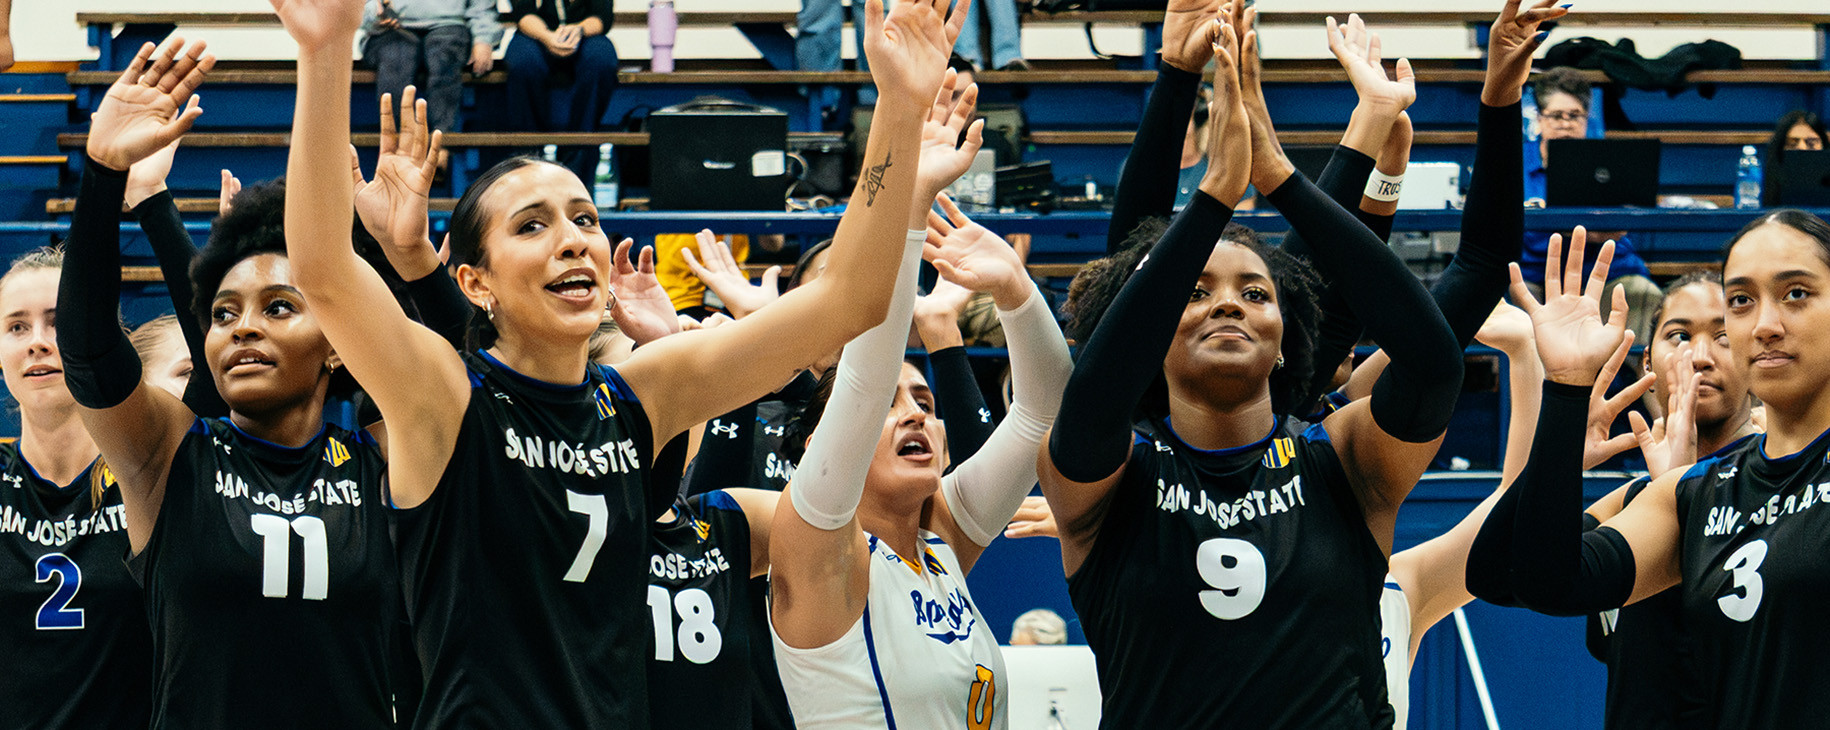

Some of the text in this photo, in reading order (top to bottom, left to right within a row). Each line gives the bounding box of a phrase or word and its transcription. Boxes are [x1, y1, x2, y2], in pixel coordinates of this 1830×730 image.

[27, 514, 77, 546] JOSÉ
[215, 470, 249, 499] SAN
[252, 493, 306, 514] JOSÉ
[1704, 506, 1742, 536] SAN
[251, 513, 329, 600] 11
[563, 489, 609, 583] 7
[35, 552, 85, 630] 2
[1196, 538, 1267, 620] 9
[1717, 539, 1768, 622] 3
[647, 585, 722, 664] 18
